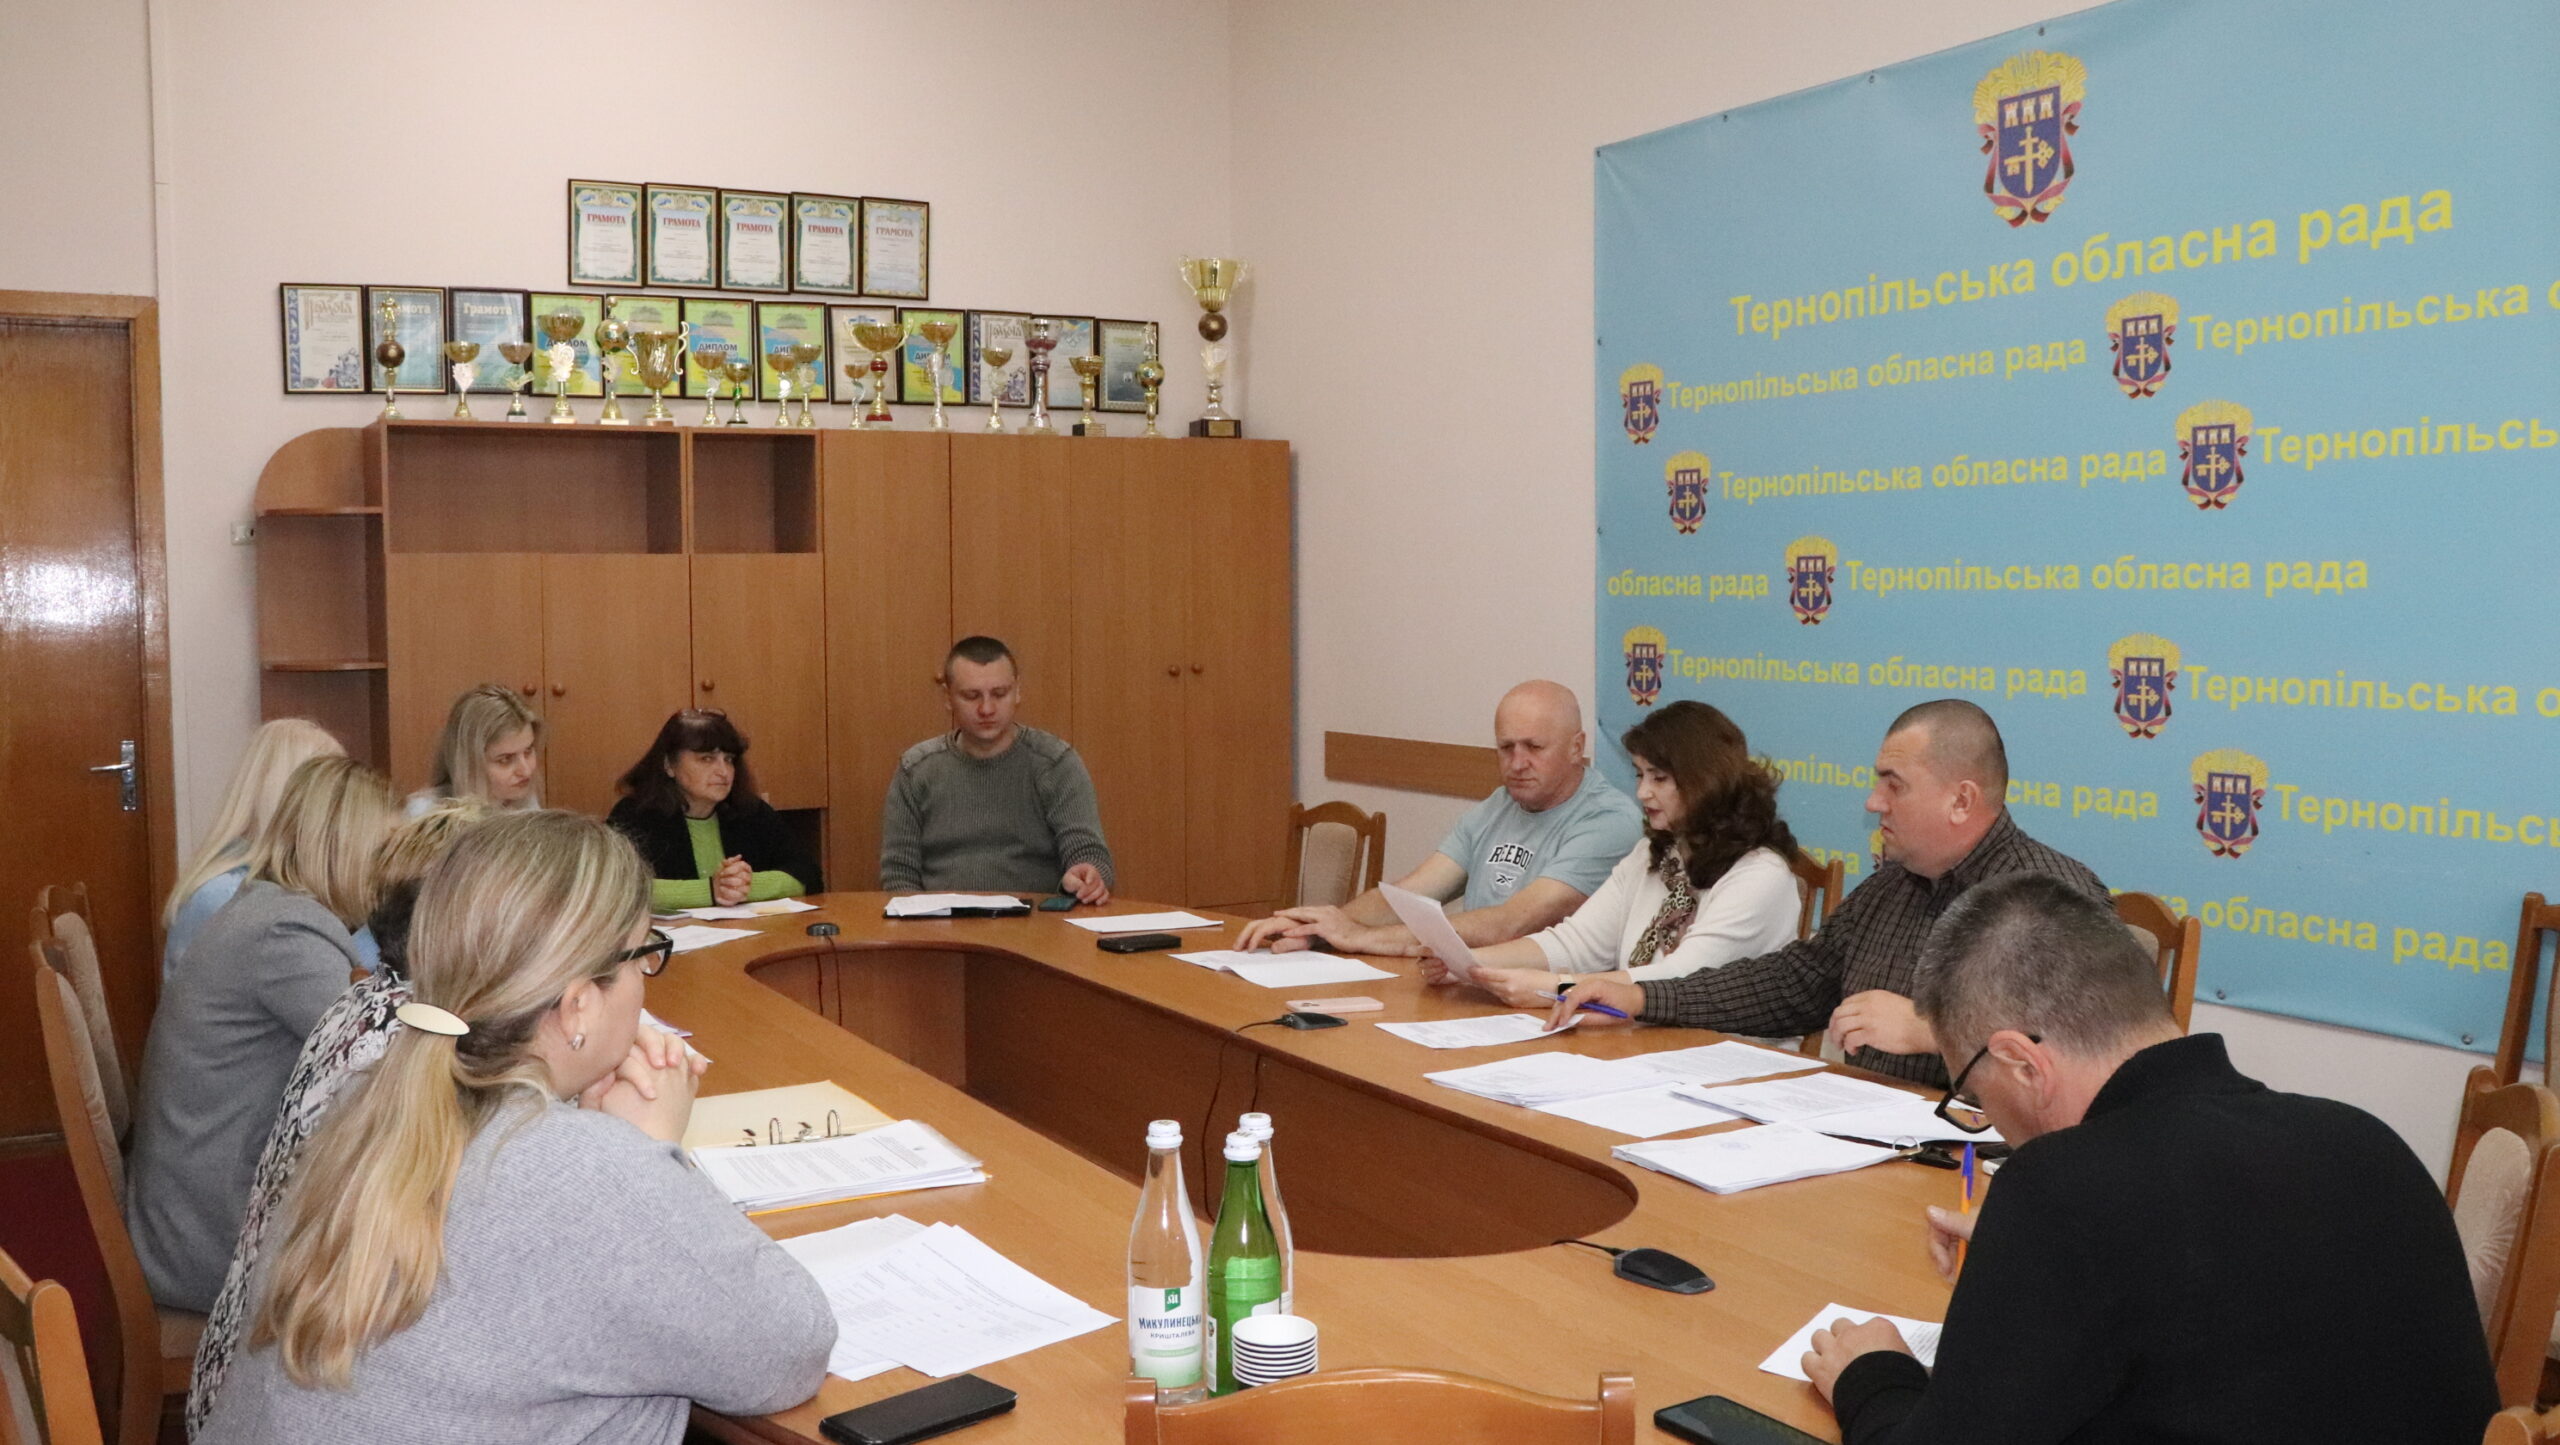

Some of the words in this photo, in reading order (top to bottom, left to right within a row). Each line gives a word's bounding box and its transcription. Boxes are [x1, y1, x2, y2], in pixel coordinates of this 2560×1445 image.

[587, 213, 626, 225] ГРАМОТА
[663, 217, 702, 229] ГРАМОТА
[736, 222, 774, 234] ГРАМОТА
[808, 223, 844, 236] ГРАМОТА
[875, 226, 915, 238] ГРАМОТА
[1730, 259, 2035, 340] Тернопільська
[2051, 212, 2277, 287] обласна
[2299, 189, 2453, 265] рада
[463, 301, 513, 316] Грамота
[2187, 284, 2529, 355] Тернопільська
[1665, 367, 1859, 412] Тернопільська
[1867, 350, 1995, 388] обласна
[2004, 339, 2087, 380] рада
[1717, 465, 1923, 505] Тернопільська
[1931, 452, 2069, 489] обласна
[2079, 449, 2167, 489] рада
[1606, 569, 1703, 597] обласна
[1708, 574, 1769, 602] рада
[1844, 559, 2081, 598] Тернопільська
[2090, 554, 2252, 590] обласна
[2265, 559, 2369, 599] рада
[1668, 648, 1860, 685] Тернопільська
[1868, 655, 1996, 691] обласна
[2005, 667, 2087, 700] рада
[2182, 665, 2518, 716] Тернопільська
[2072, 786, 2158, 821] рада
[2198, 894, 2378, 951] обласна
[2393, 927, 2510, 974] рада
